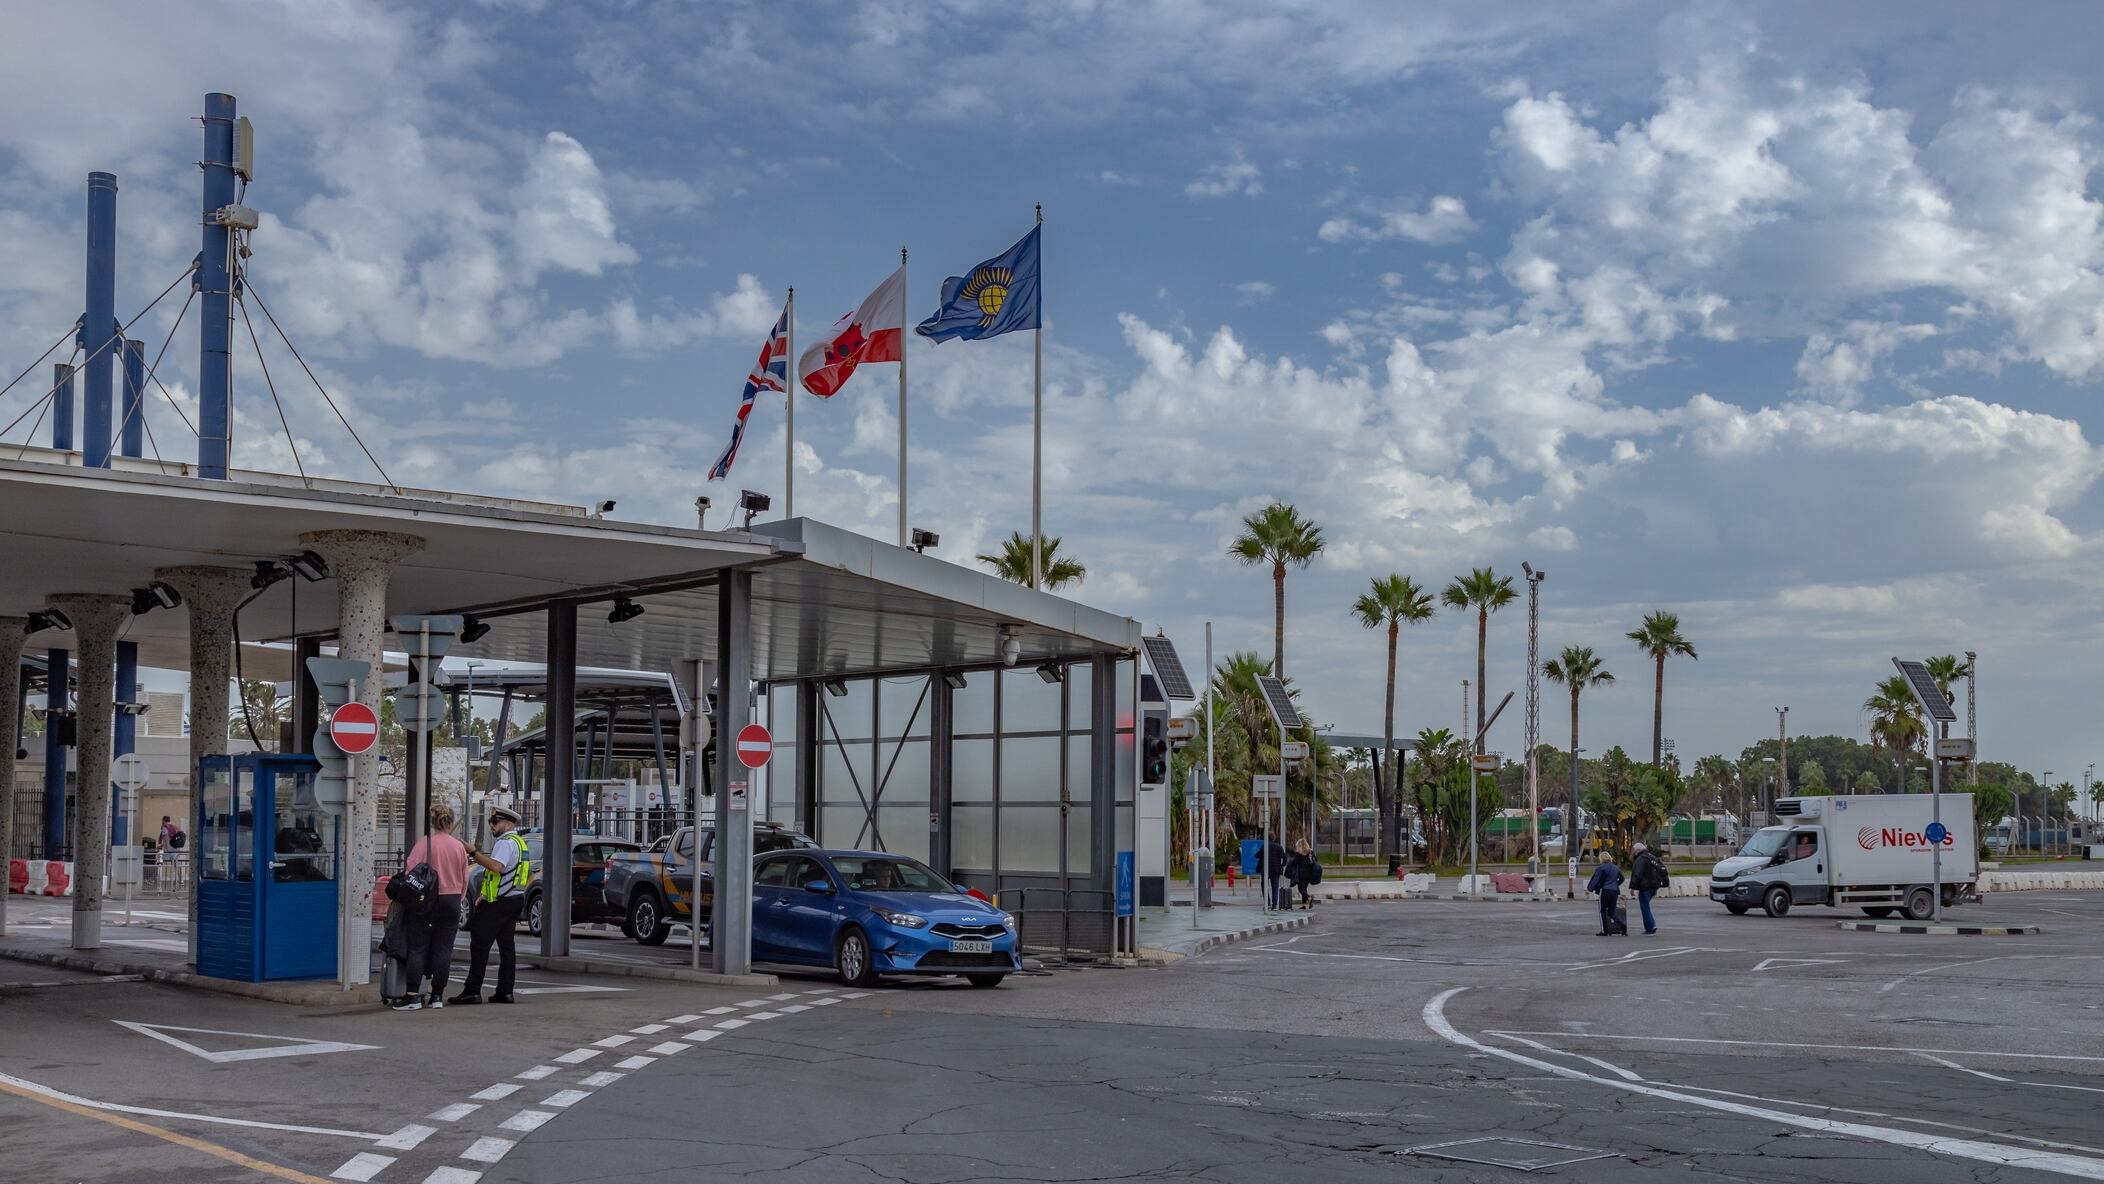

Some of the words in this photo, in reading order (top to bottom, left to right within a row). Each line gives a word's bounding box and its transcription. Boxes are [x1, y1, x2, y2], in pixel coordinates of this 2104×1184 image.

[1882, 828, 1953, 847] Nievs
[954, 942, 974, 951] 5046
[976, 943, 990, 951] LXH
